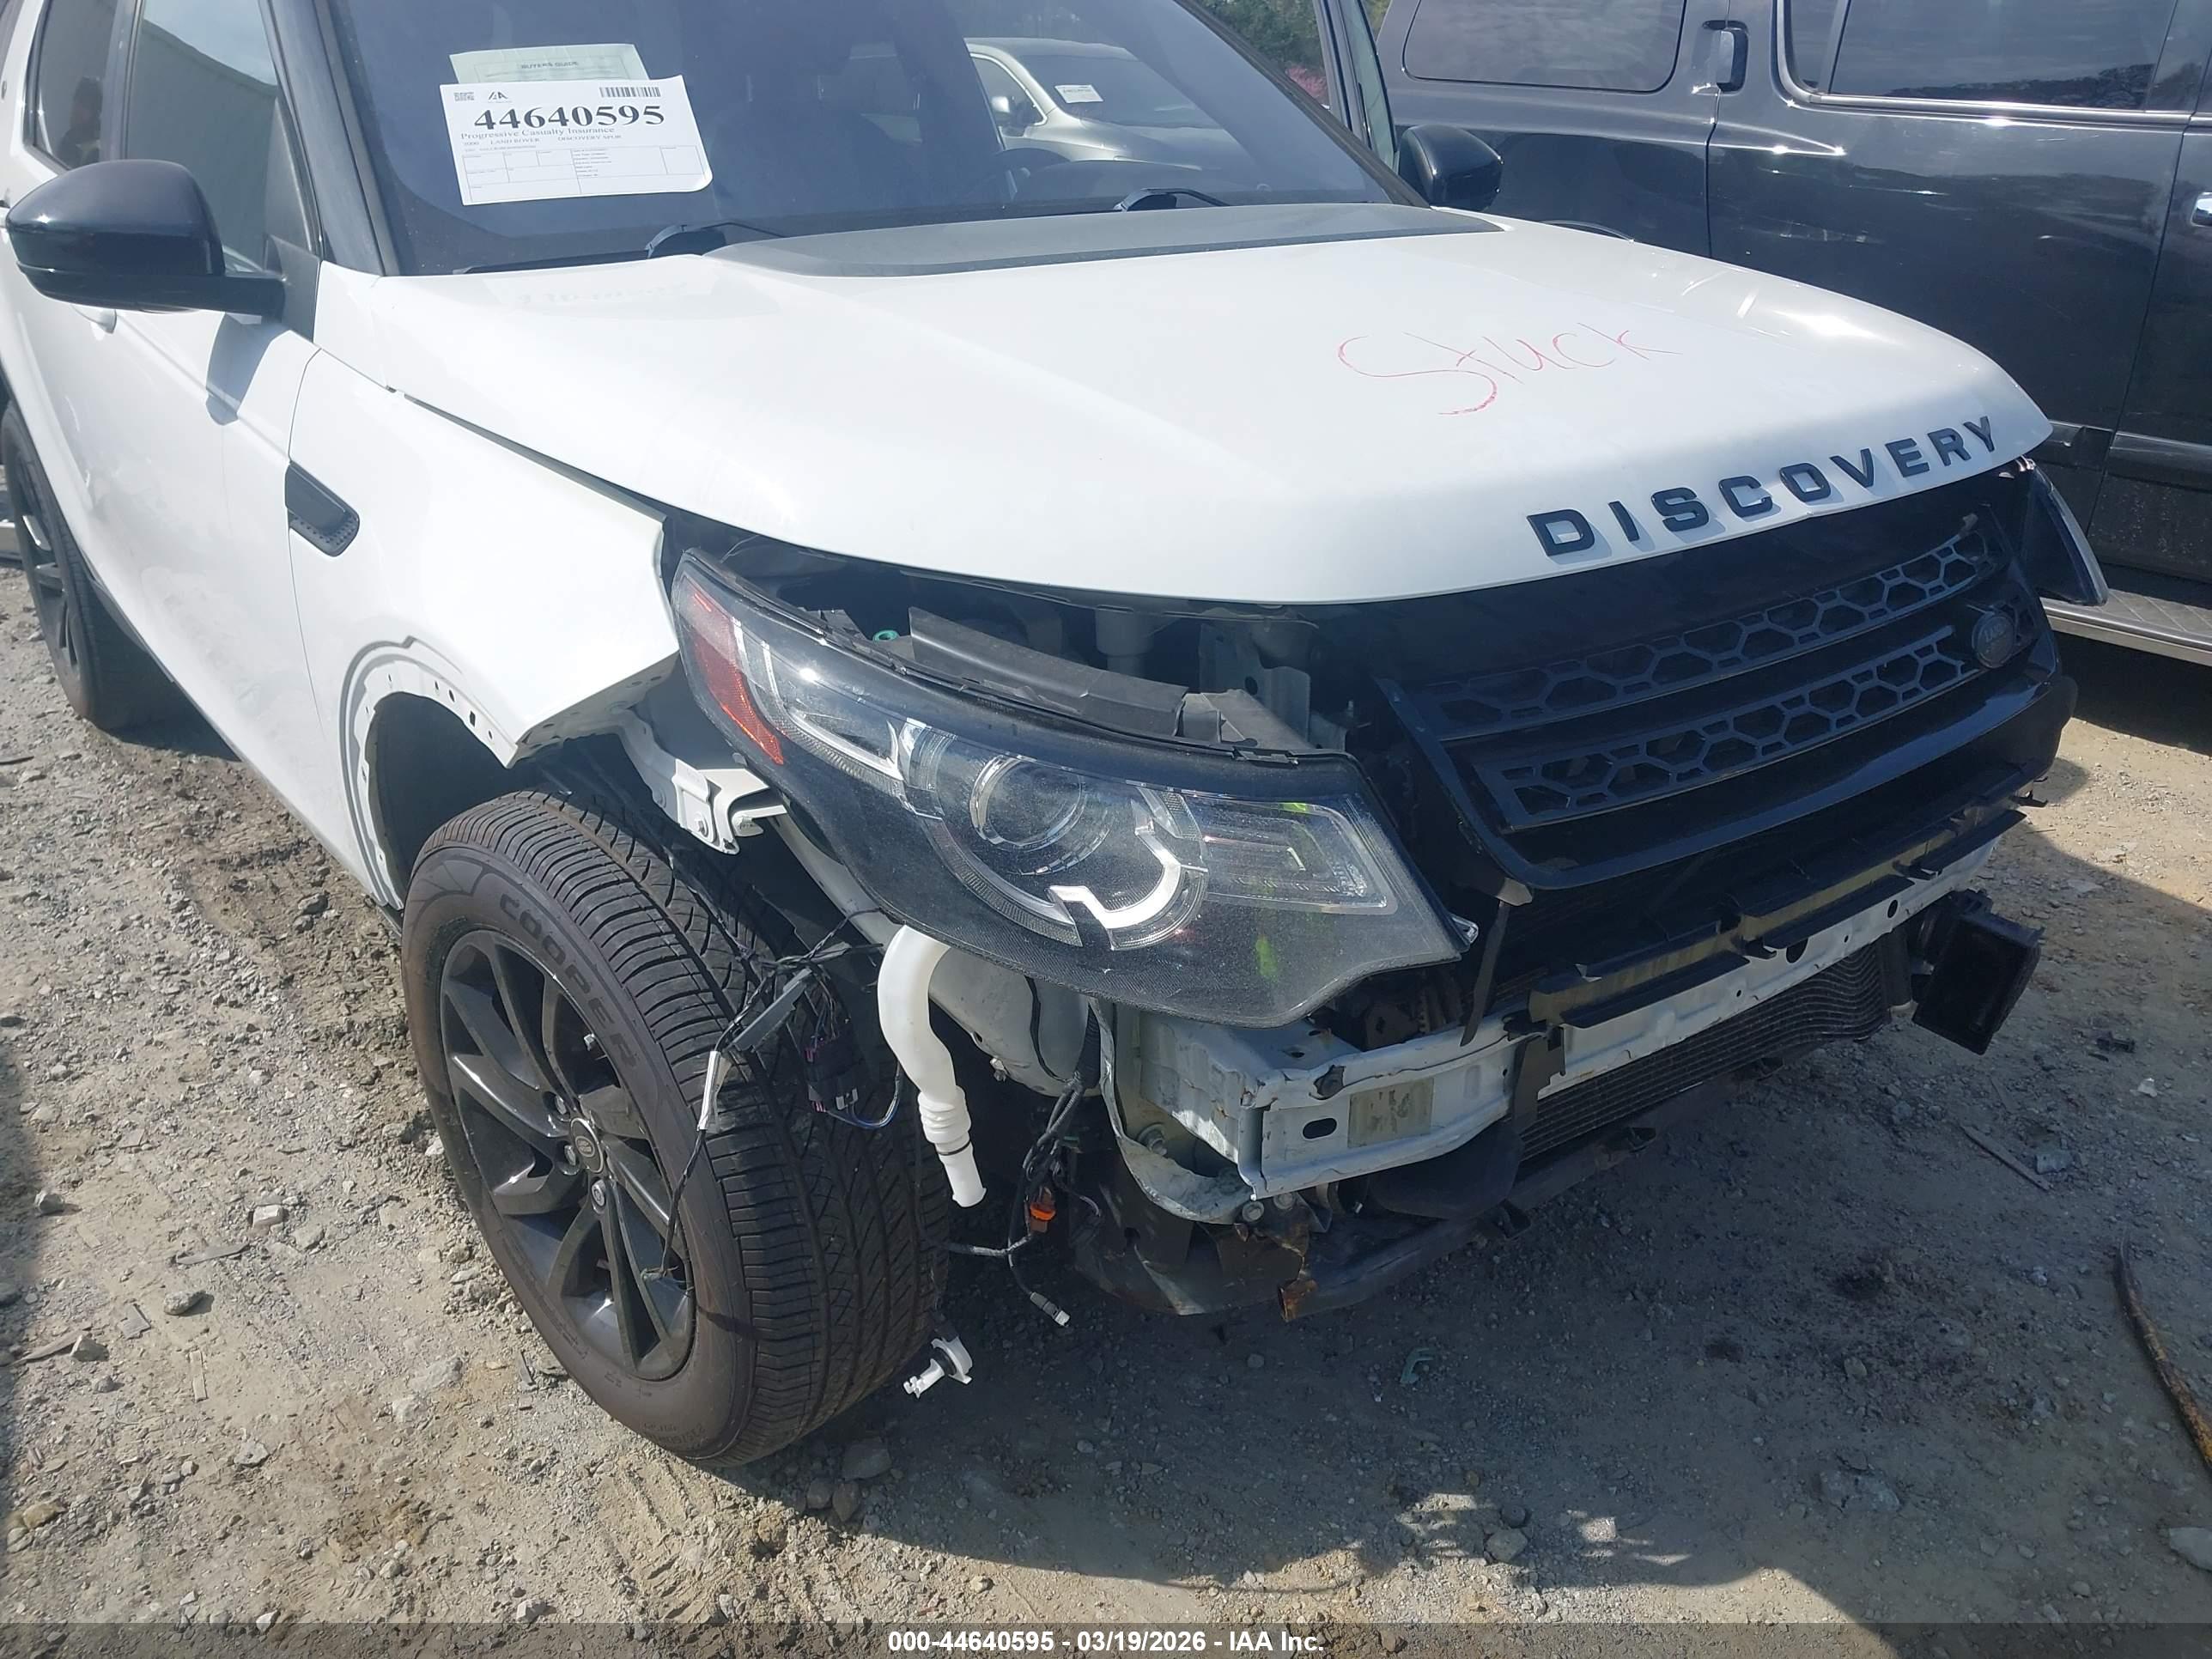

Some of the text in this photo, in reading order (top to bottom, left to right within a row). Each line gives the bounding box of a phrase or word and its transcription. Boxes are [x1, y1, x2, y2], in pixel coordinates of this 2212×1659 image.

[461, 126, 616, 141] Progressive Casualty Insurance
[474, 105, 665, 130] 44640595
[1527, 416, 1996, 557] DISCOVERY
[499, 893, 637, 1070] COOPER
